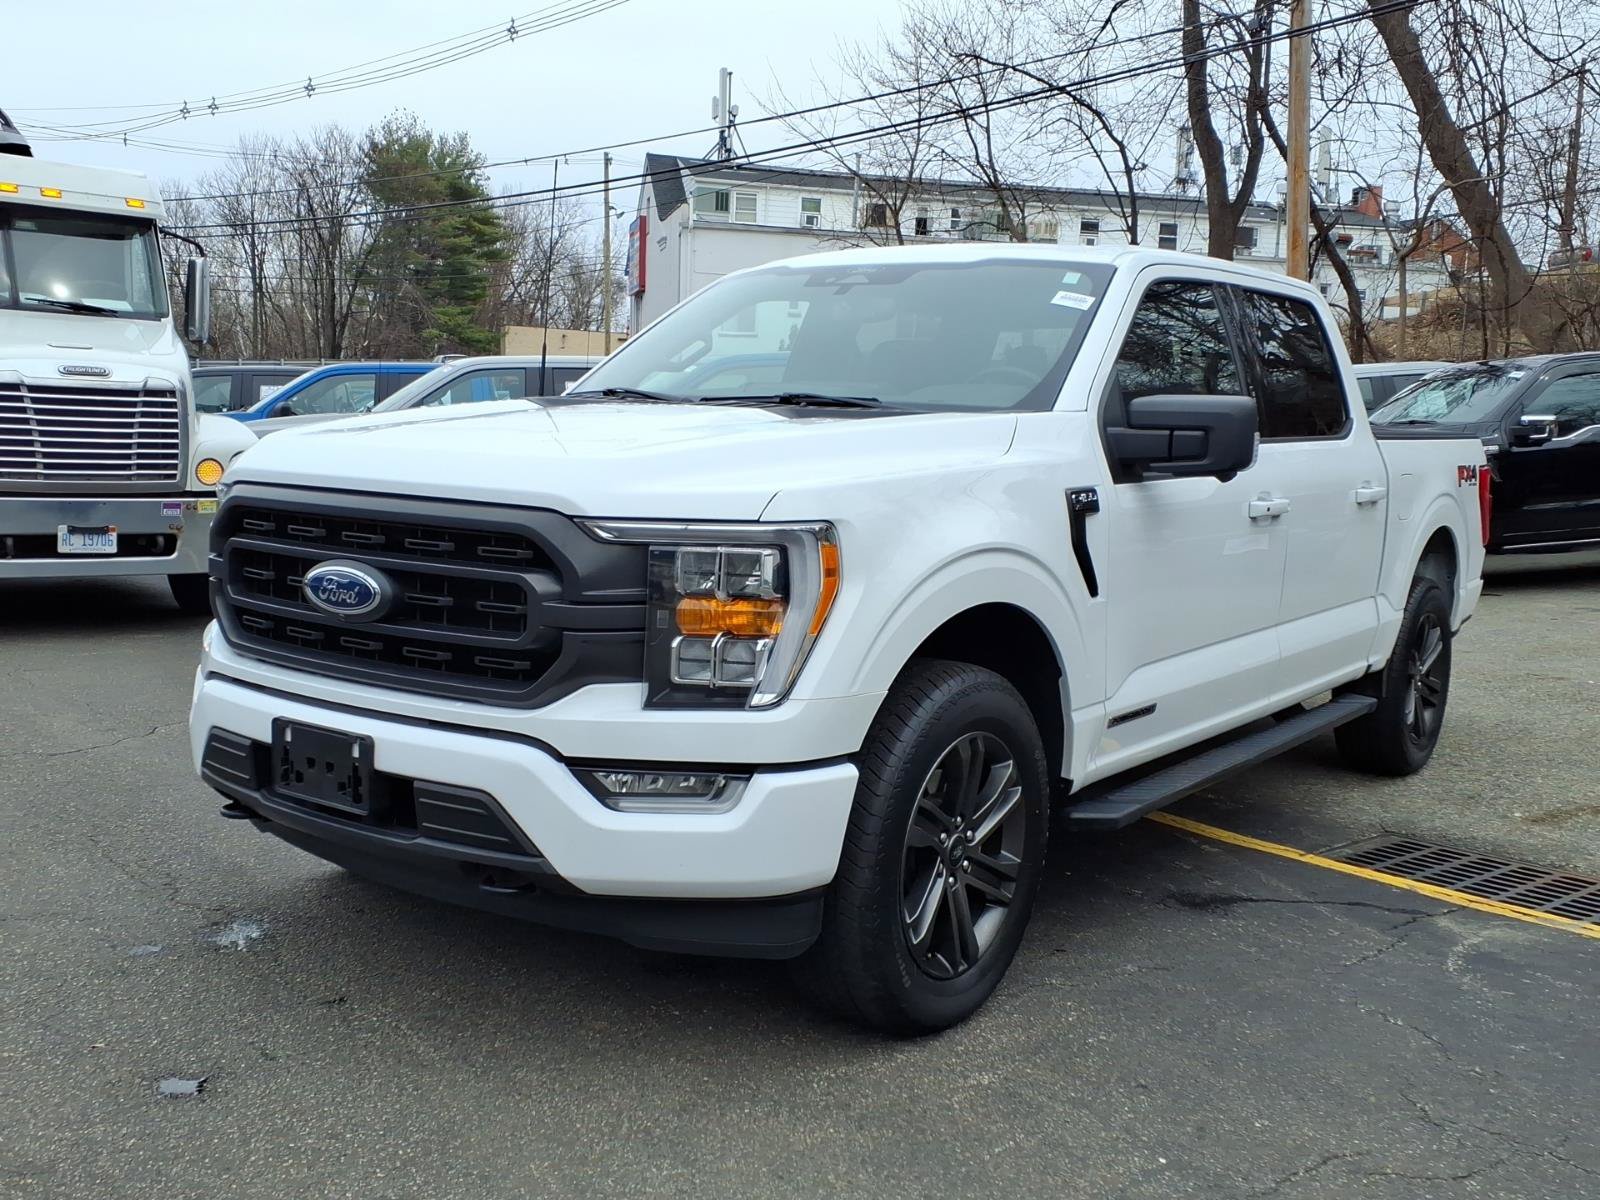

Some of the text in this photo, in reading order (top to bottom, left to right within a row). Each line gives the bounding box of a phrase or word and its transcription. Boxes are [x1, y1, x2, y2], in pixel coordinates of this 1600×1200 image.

[1457, 464, 1477, 487] FX4
[81, 533, 114, 547] 19706
[319, 575, 361, 604] Ford
